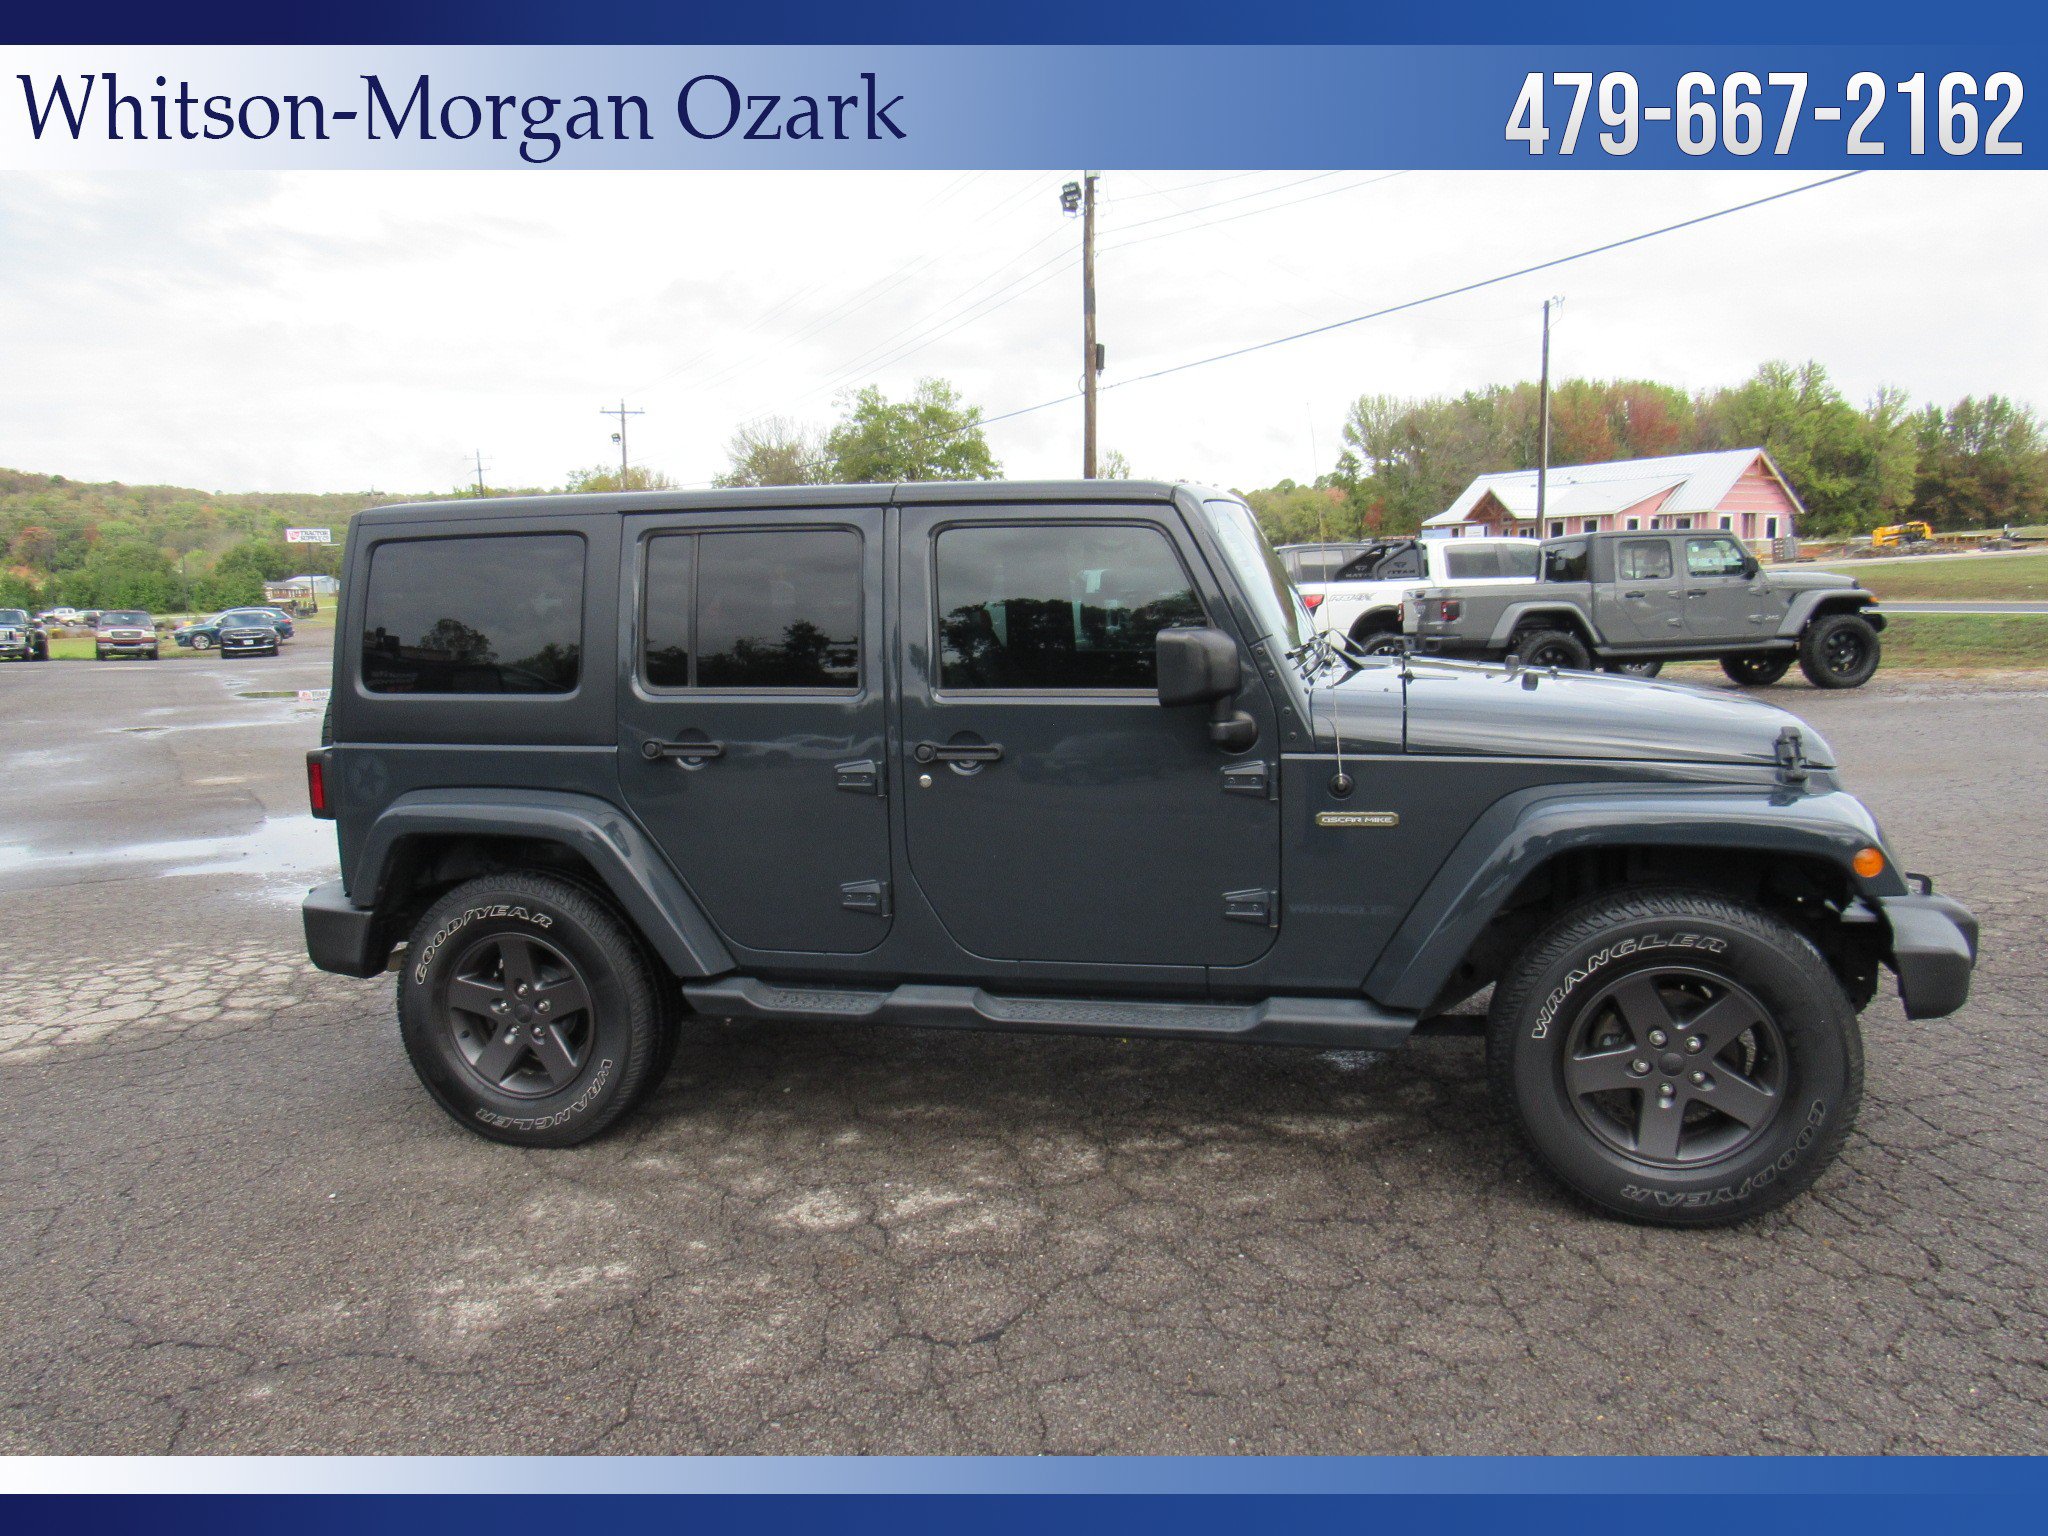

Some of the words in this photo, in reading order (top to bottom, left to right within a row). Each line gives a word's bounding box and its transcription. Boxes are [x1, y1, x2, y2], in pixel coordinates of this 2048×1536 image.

[415, 905, 553, 985] GOODYEAR
[1531, 932, 1728, 1039] WRANGLER
[475, 1058, 613, 1130] WRANGLER
[1620, 1100, 1826, 1207] GOODYEAR
